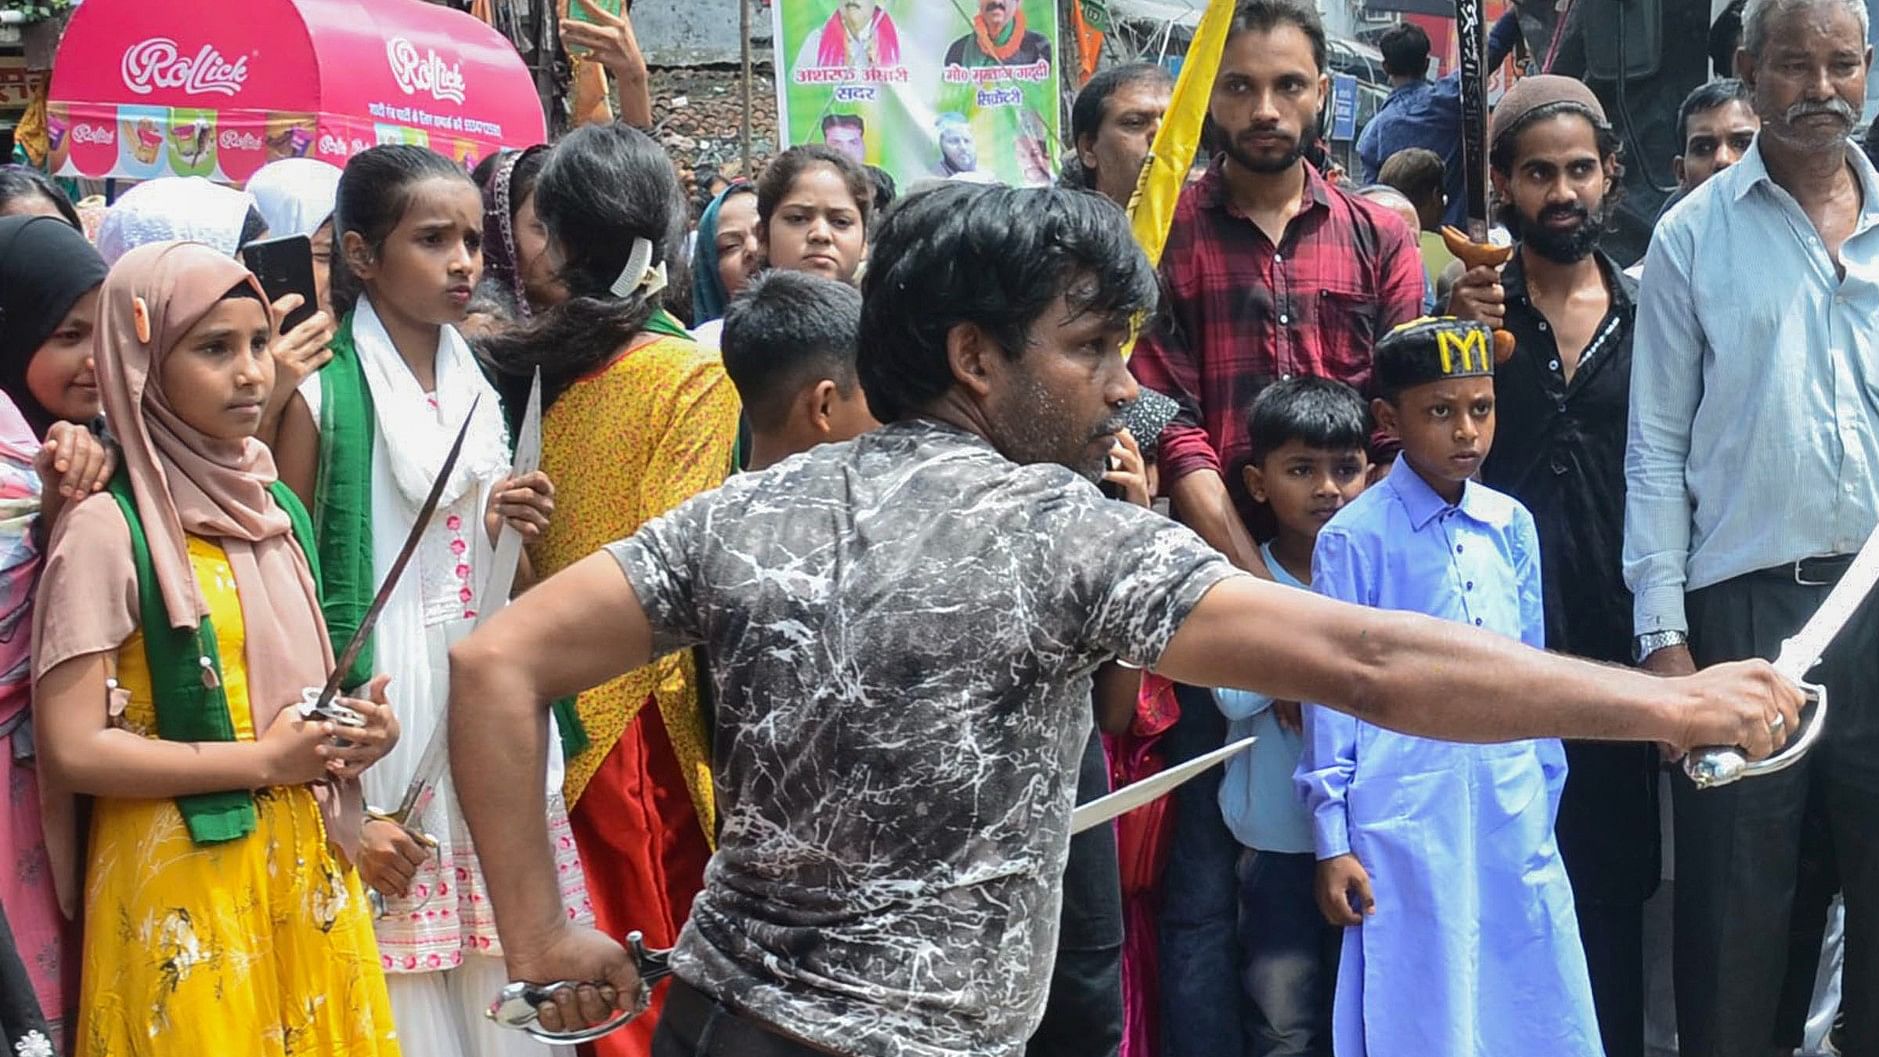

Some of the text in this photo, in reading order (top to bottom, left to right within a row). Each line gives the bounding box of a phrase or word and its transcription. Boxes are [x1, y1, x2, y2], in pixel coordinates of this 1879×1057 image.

[122, 37, 248, 96] Rollick
[387, 37, 466, 105] Rollick
[836, 86, 876, 101] सदर
